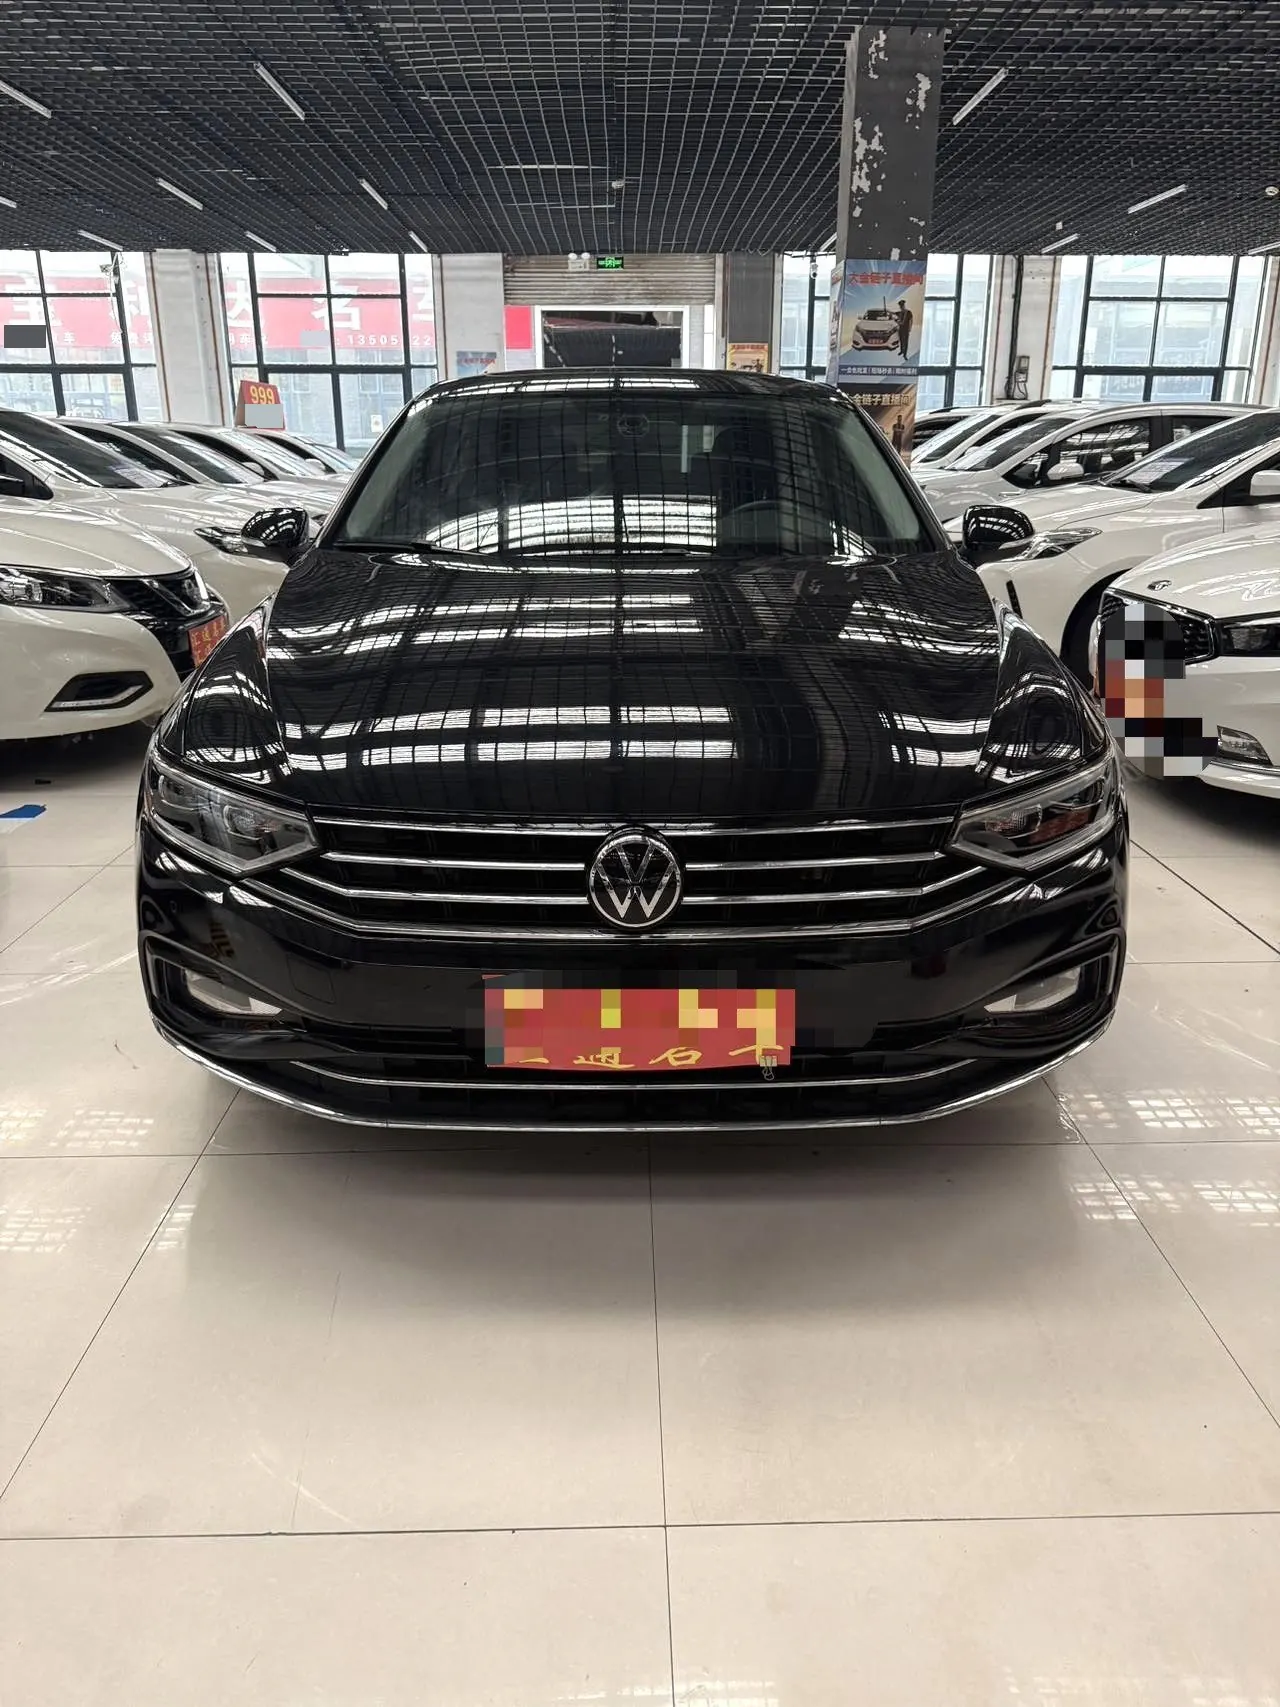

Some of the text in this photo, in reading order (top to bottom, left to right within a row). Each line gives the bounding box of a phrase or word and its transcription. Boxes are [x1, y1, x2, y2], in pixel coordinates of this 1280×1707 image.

[250, 385, 276, 405] 999
[846, 393, 910, 406] 金链子直播间
